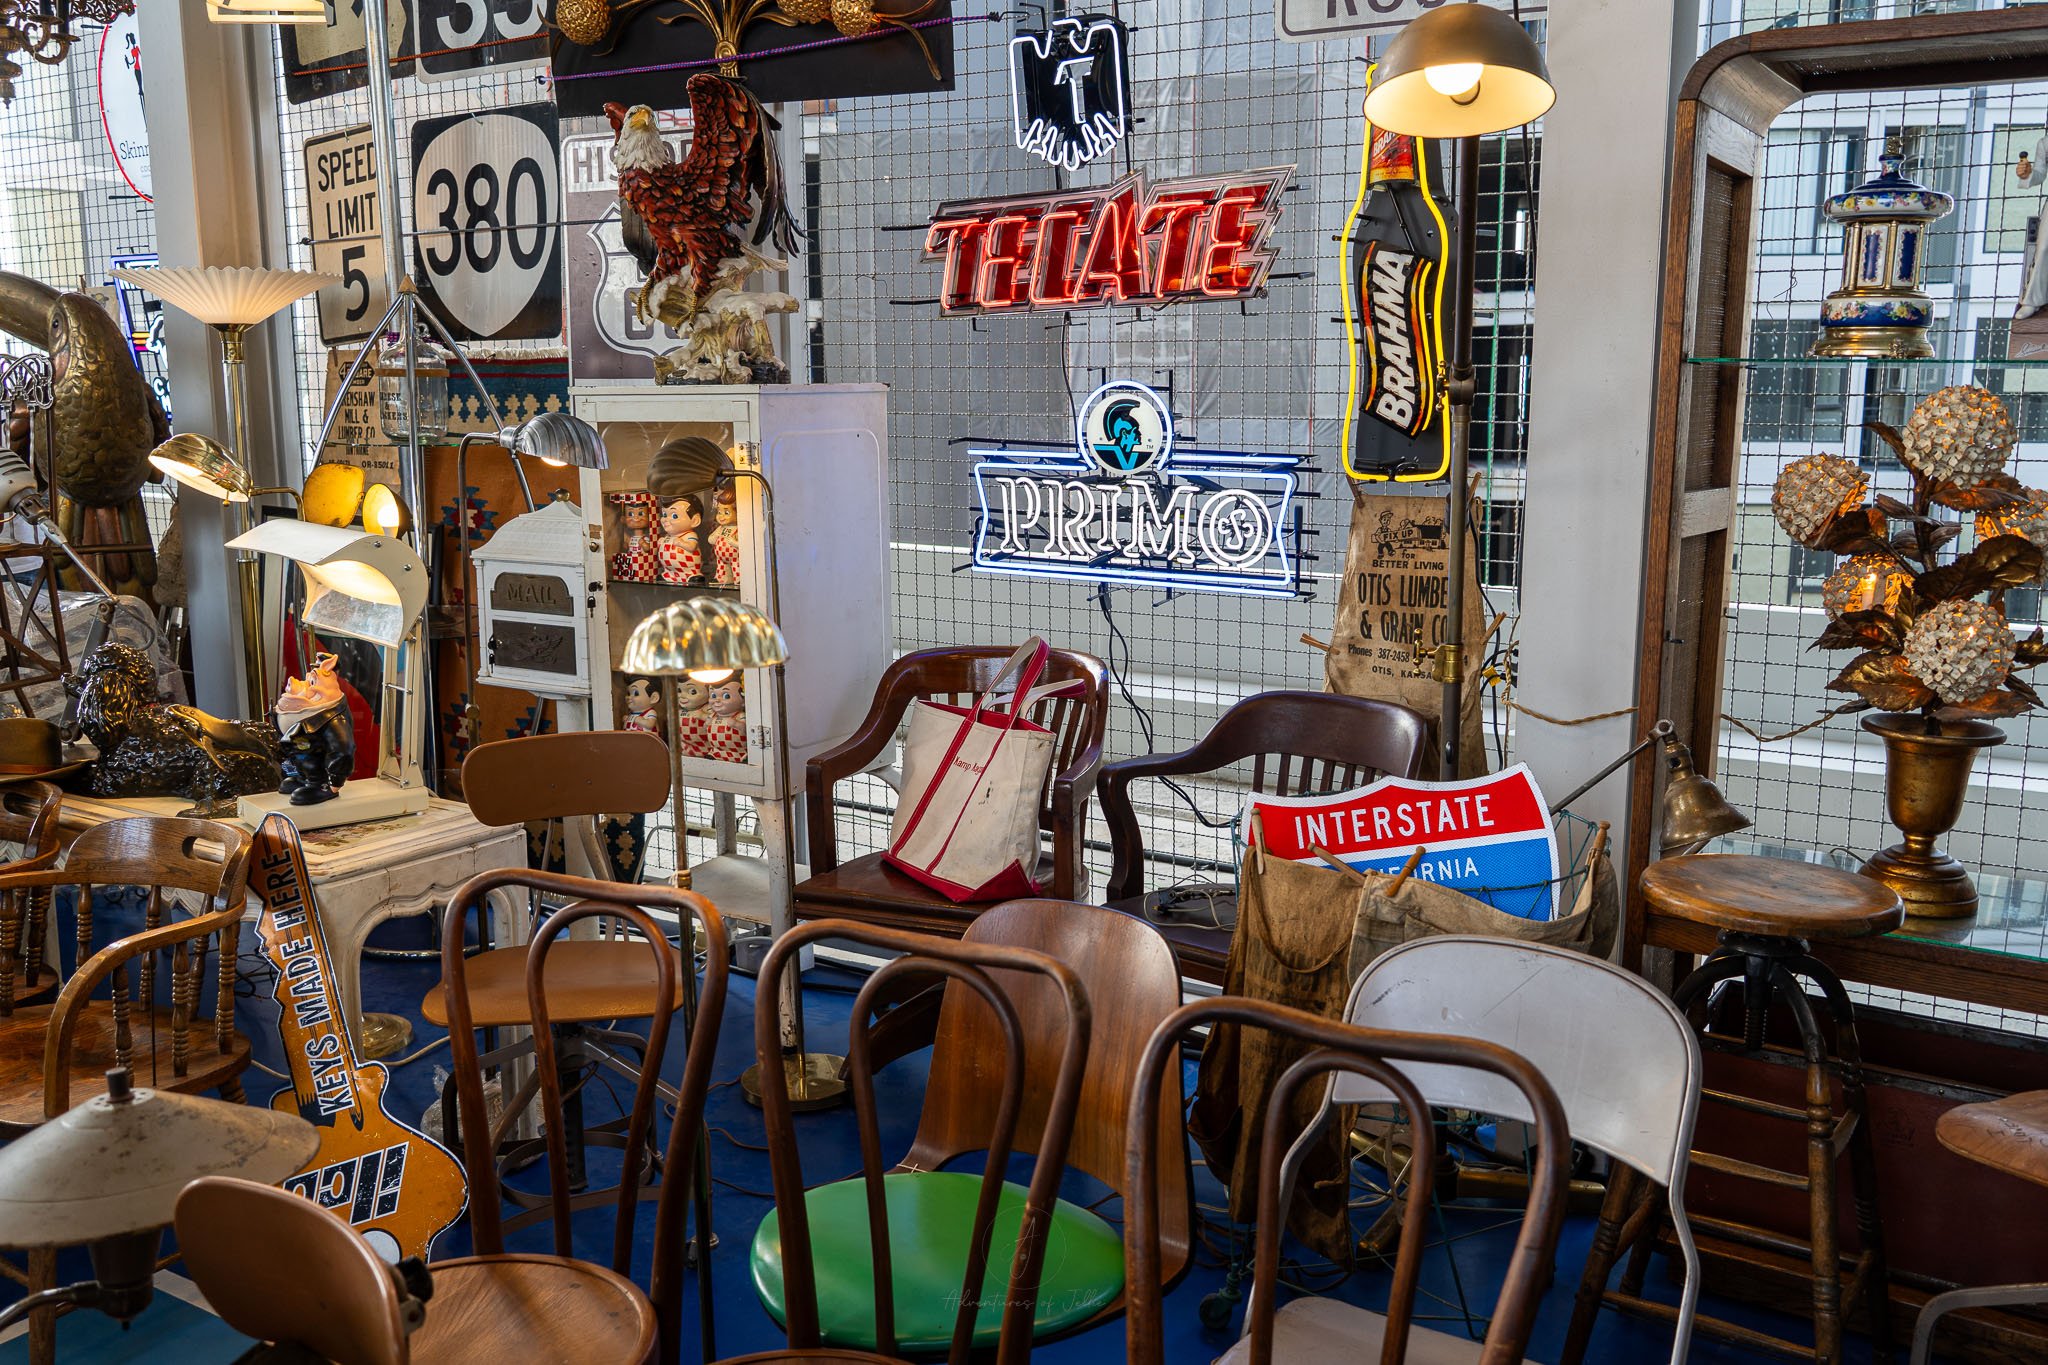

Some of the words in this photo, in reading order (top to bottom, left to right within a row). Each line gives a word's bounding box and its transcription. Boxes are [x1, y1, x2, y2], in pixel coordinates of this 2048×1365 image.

[317, 141, 376, 192] SPEED
[326, 192, 376, 240] LIMIT
[426, 157, 549, 277] 380
[922, 180, 1277, 314] TECATE
[341, 245, 370, 322] 5
[1370, 250, 1415, 430] BRAHMA
[341, 391, 375, 407] RENSHAW
[344, 409, 360, 424] MILL
[362, 409, 369, 424] &
[995, 476, 1274, 569] PRIMO
[1383, 531, 1399, 541] FIX
[1401, 529, 1414, 539] UP
[1372, 559, 1409, 569] BETTER
[1414, 561, 1444, 571] LIVING
[507, 583, 557, 605] MAIL
[1358, 572, 1392, 606] OTIS
[1400, 575, 1448, 609] LUMBE
[1360, 609, 1373, 640] &
[1380, 610, 1425, 646] GRAIN
[1348, 643, 1373, 658] Phones
[1378, 648, 1410, 663] 387-2458
[1372, 665, 1395, 677] OTIS,
[954, 756, 971, 772] Kamp
[1294, 794, 1495, 850] INTERSTATE
[260, 847, 308, 932] HERE
[279, 935, 333, 1029] MADE
[304, 1033, 356, 1117] KEYS
